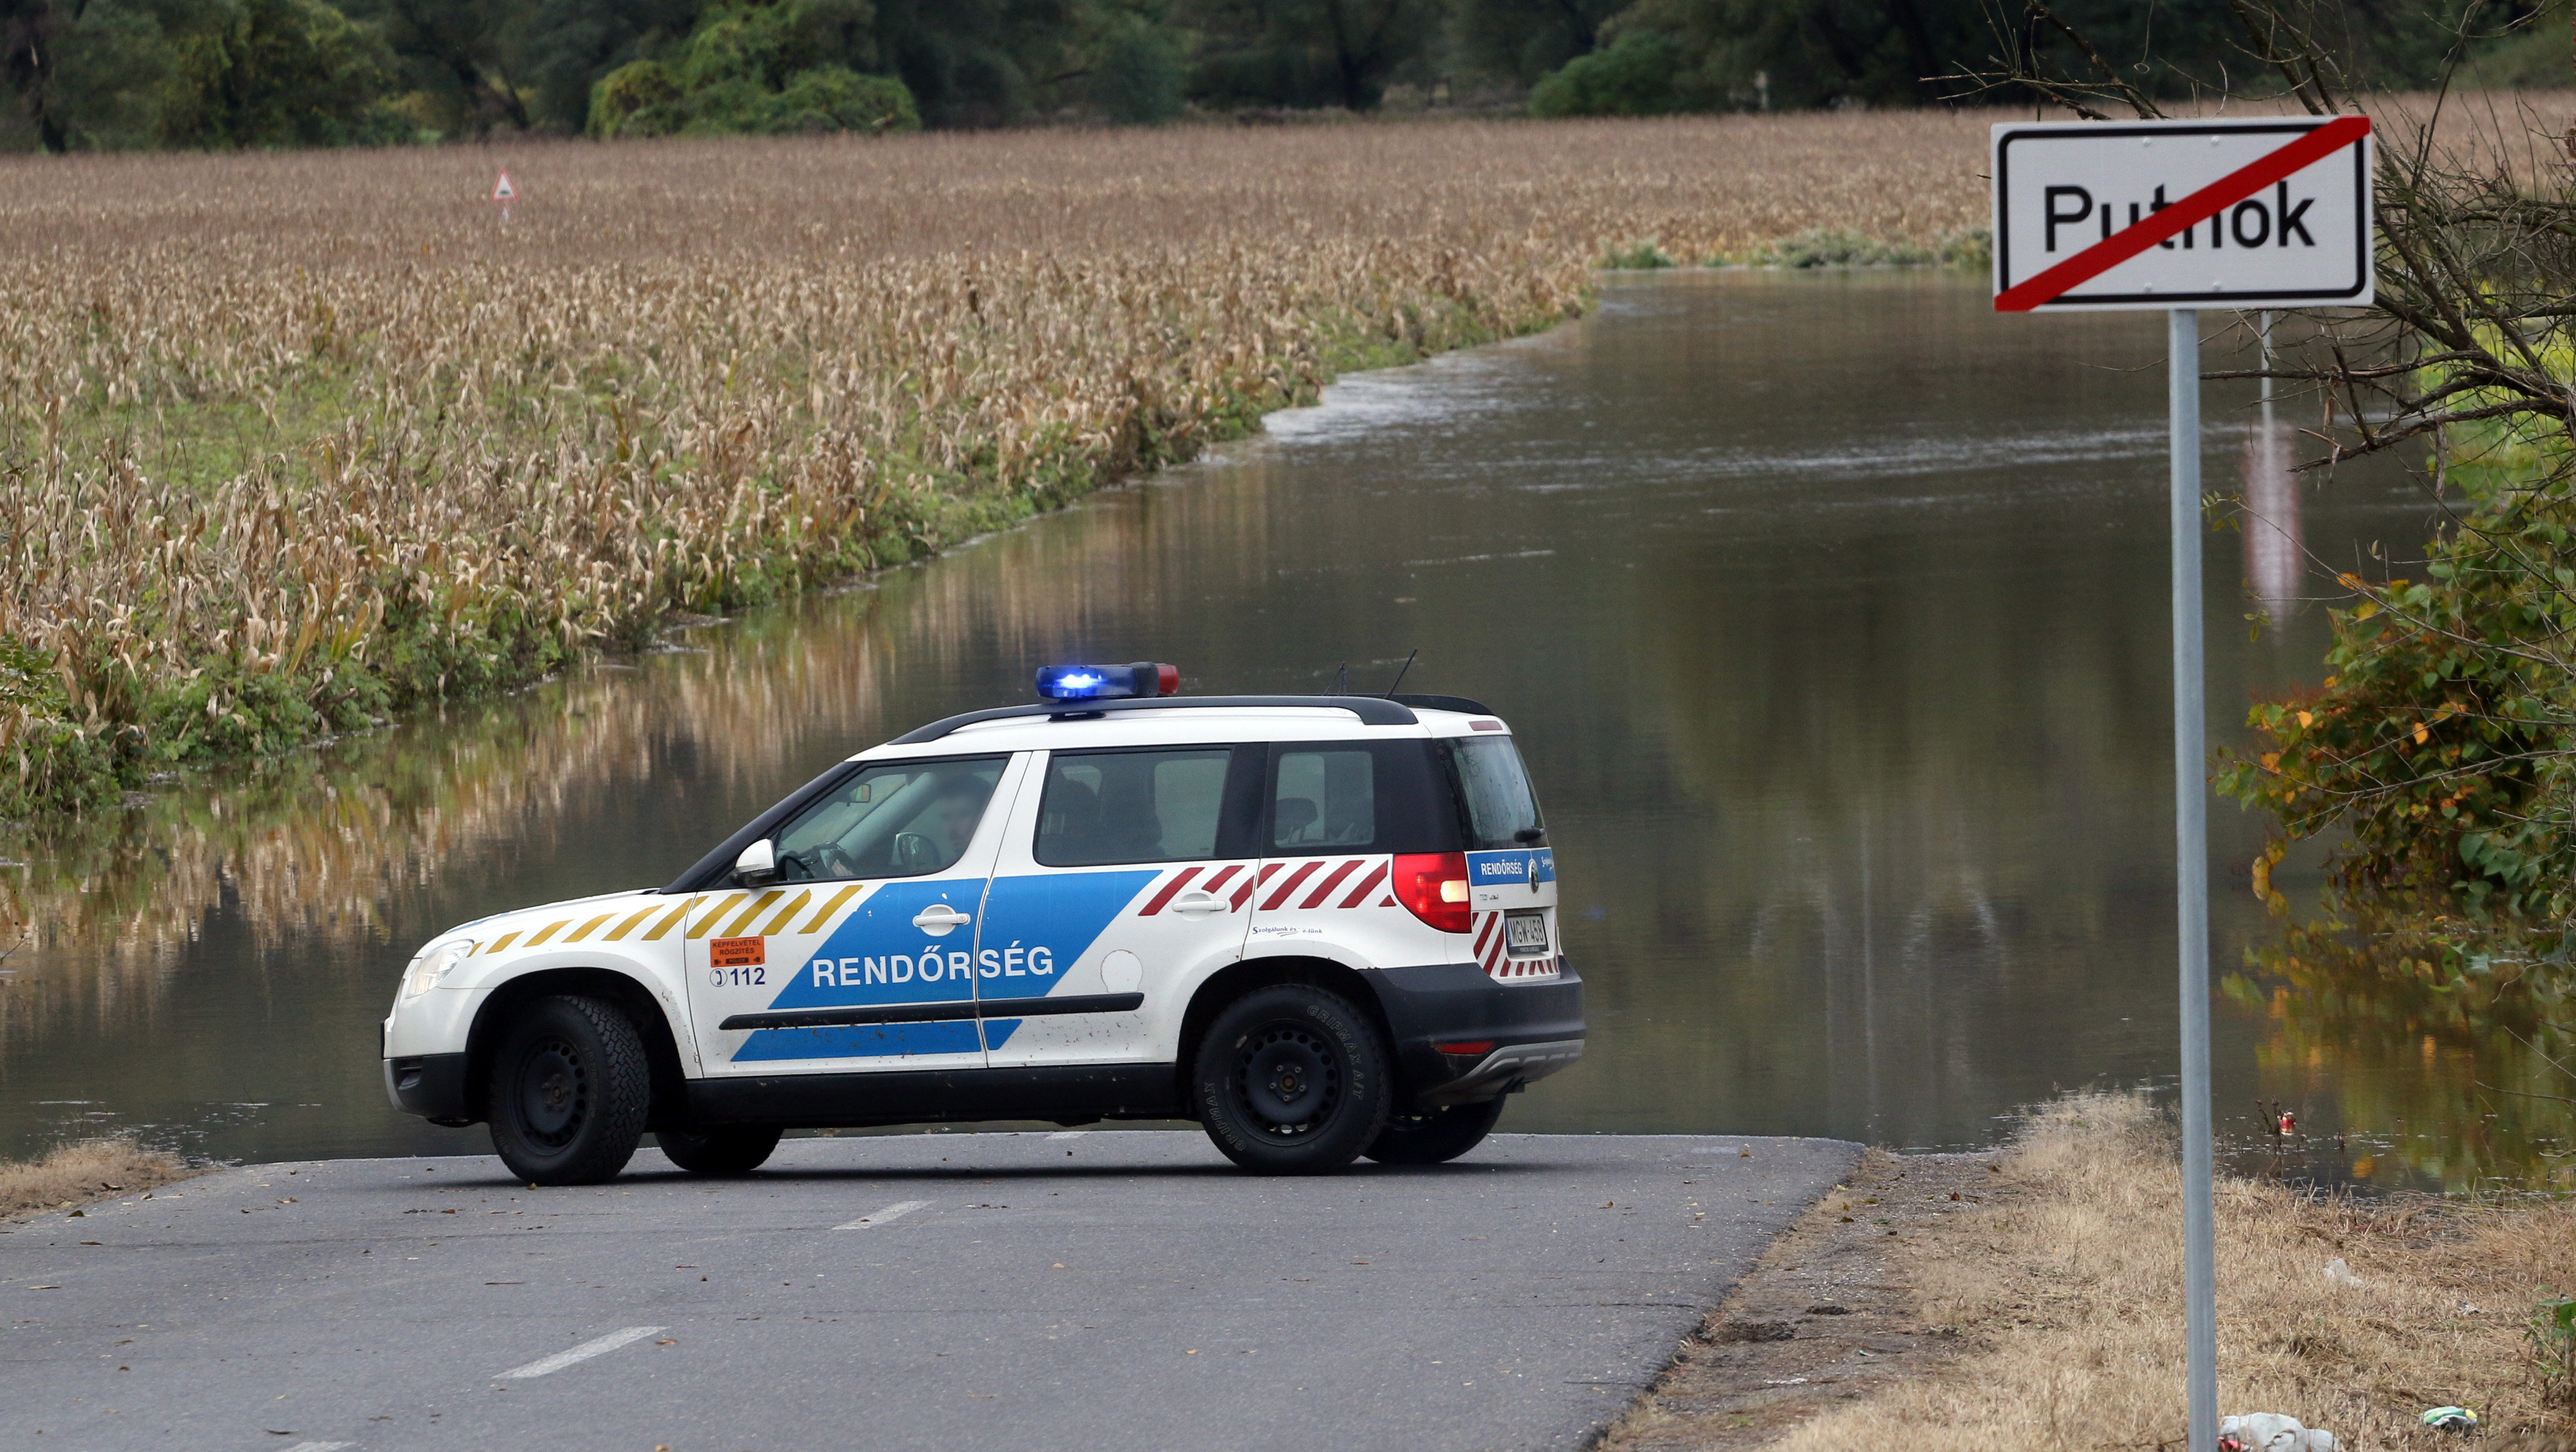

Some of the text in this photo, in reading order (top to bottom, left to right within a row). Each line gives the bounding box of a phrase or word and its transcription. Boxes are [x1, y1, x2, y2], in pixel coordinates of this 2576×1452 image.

[2045, 180, 2315, 253] Putnok
[1480, 859, 1523, 876] RENDŐRSÉG
[1252, 926, 1288, 935] Szolgálunk
[1509, 919, 1543, 943] MGW-458
[813, 940, 1053, 988] RENDŐRSÉG
[730, 967, 766, 986] 112
[1307, 1005, 1362, 1066] GRIPMAX
